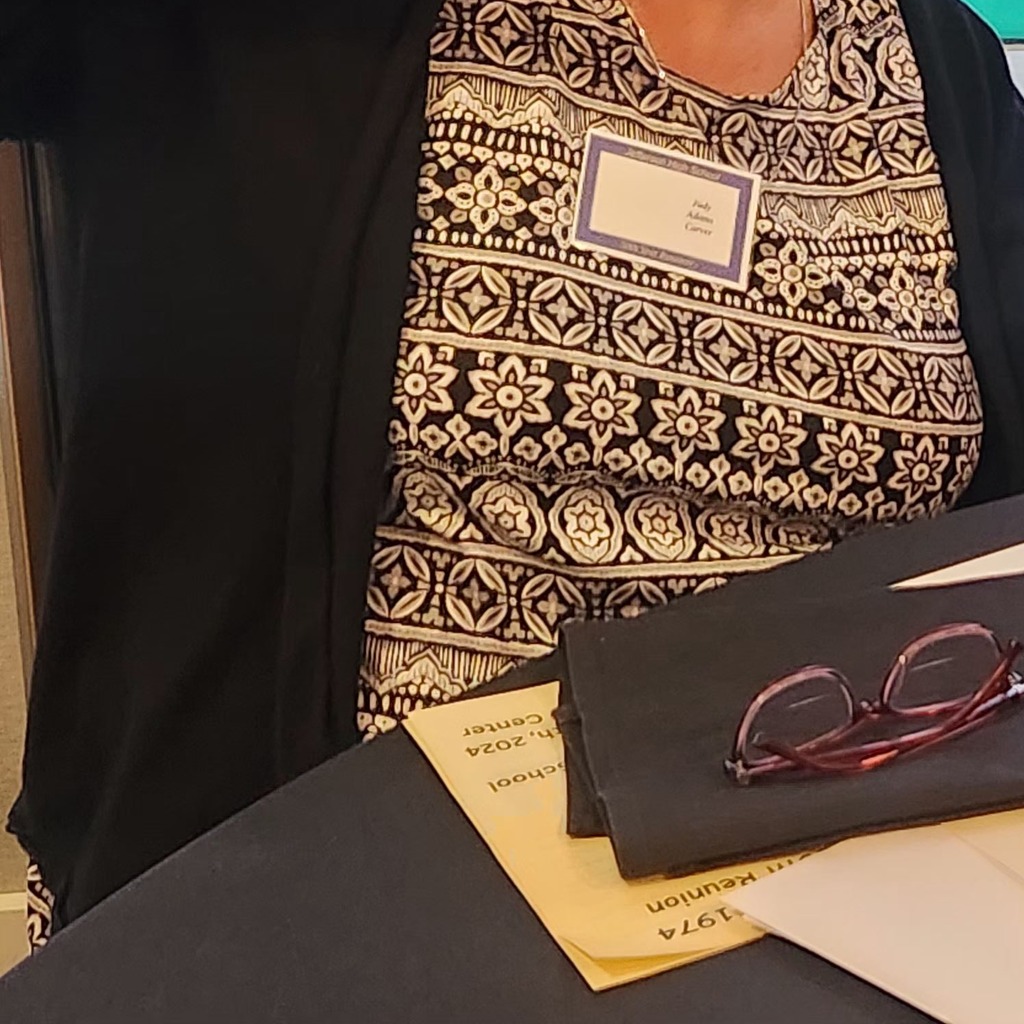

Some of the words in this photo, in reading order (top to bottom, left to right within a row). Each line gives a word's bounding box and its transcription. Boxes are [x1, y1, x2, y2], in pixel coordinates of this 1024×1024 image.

[462, 713, 543, 737] Center
[464, 735, 527, 757] 2024
[645, 871, 757, 914] Reunion
[658, 906, 733, 941] 1974
